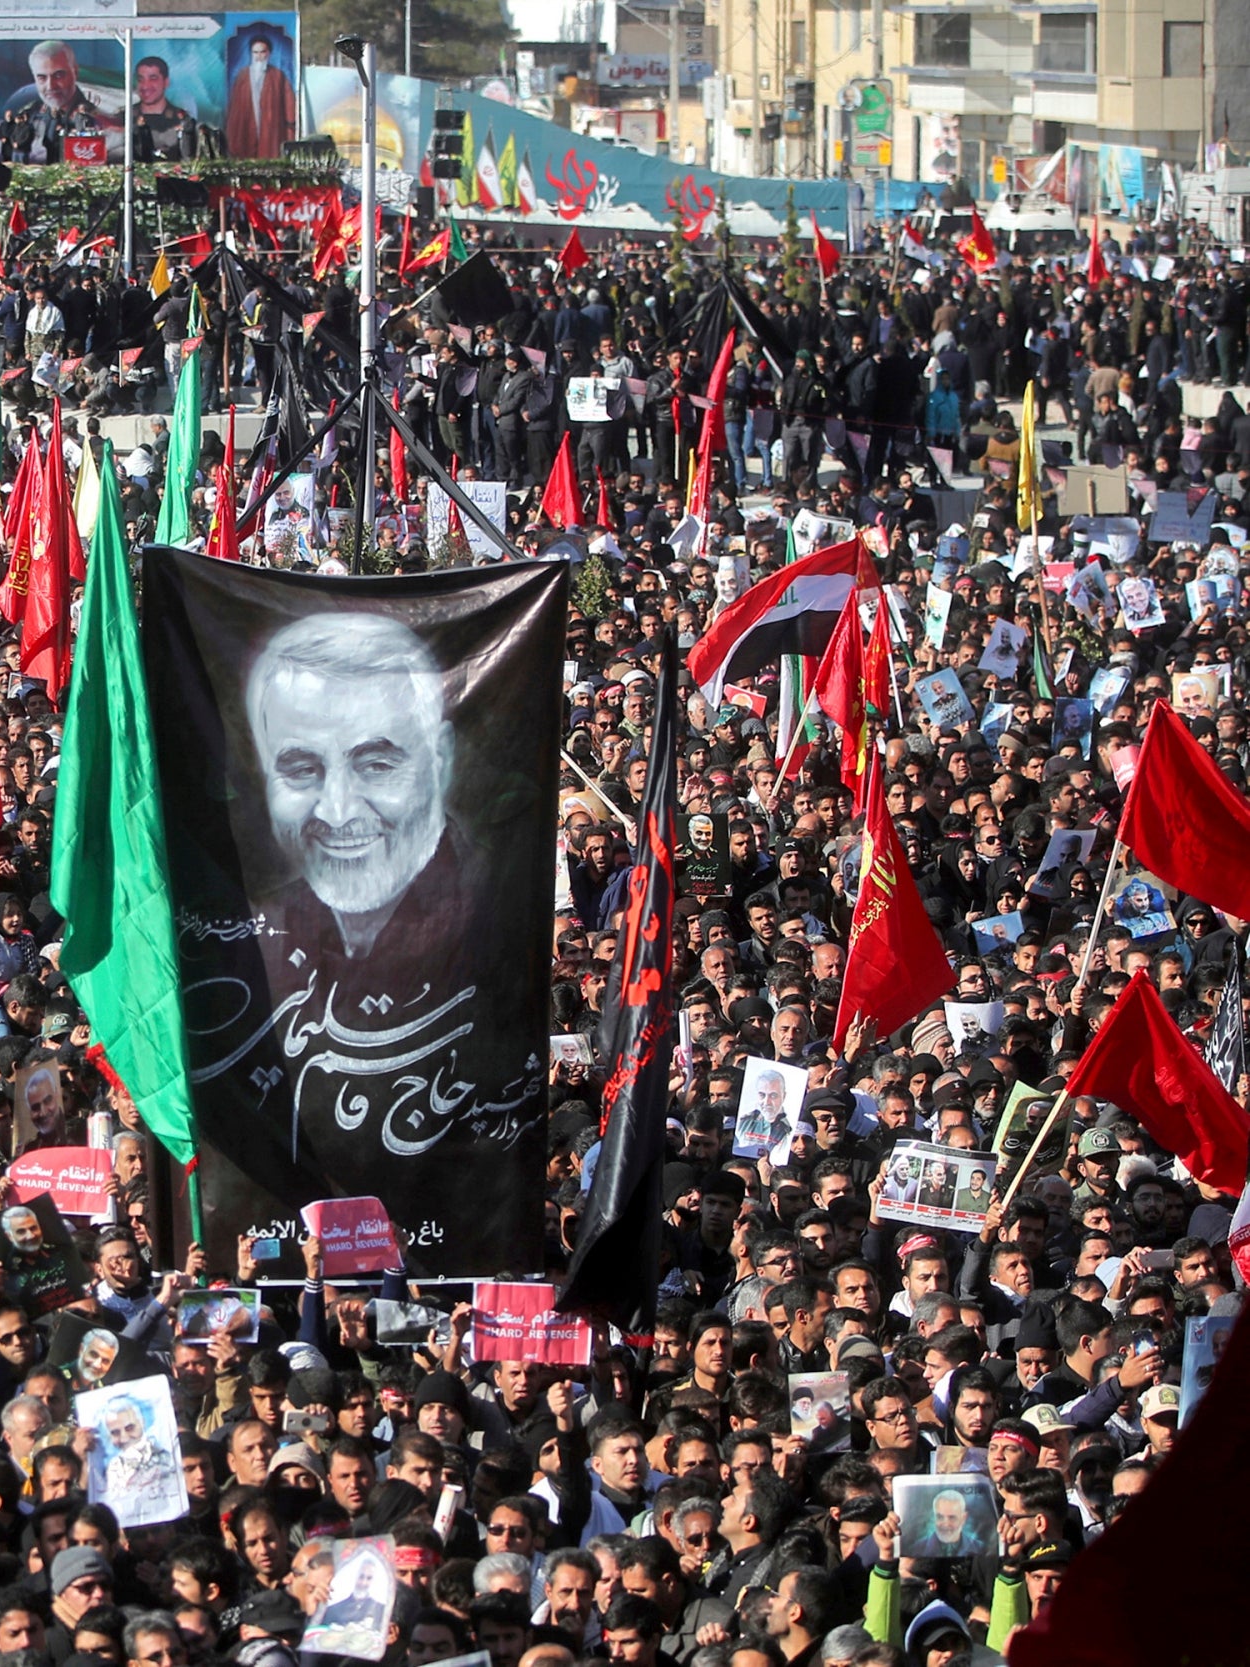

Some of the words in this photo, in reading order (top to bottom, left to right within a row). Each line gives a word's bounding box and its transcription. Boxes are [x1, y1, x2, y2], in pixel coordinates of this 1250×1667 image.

[381, 1048, 477, 1156] حاج
[16, 1162, 105, 1183] #انتقام_سخت
[16, 1178, 102, 1194] #HARD_REVENGE
[320, 1218, 390, 1240] #انتقام_سخت
[417, 1218, 445, 1246] باغ
[325, 1237, 392, 1253] #HARD_REVENGE
[484, 1327, 580, 1340] #HARD_REVENGE
